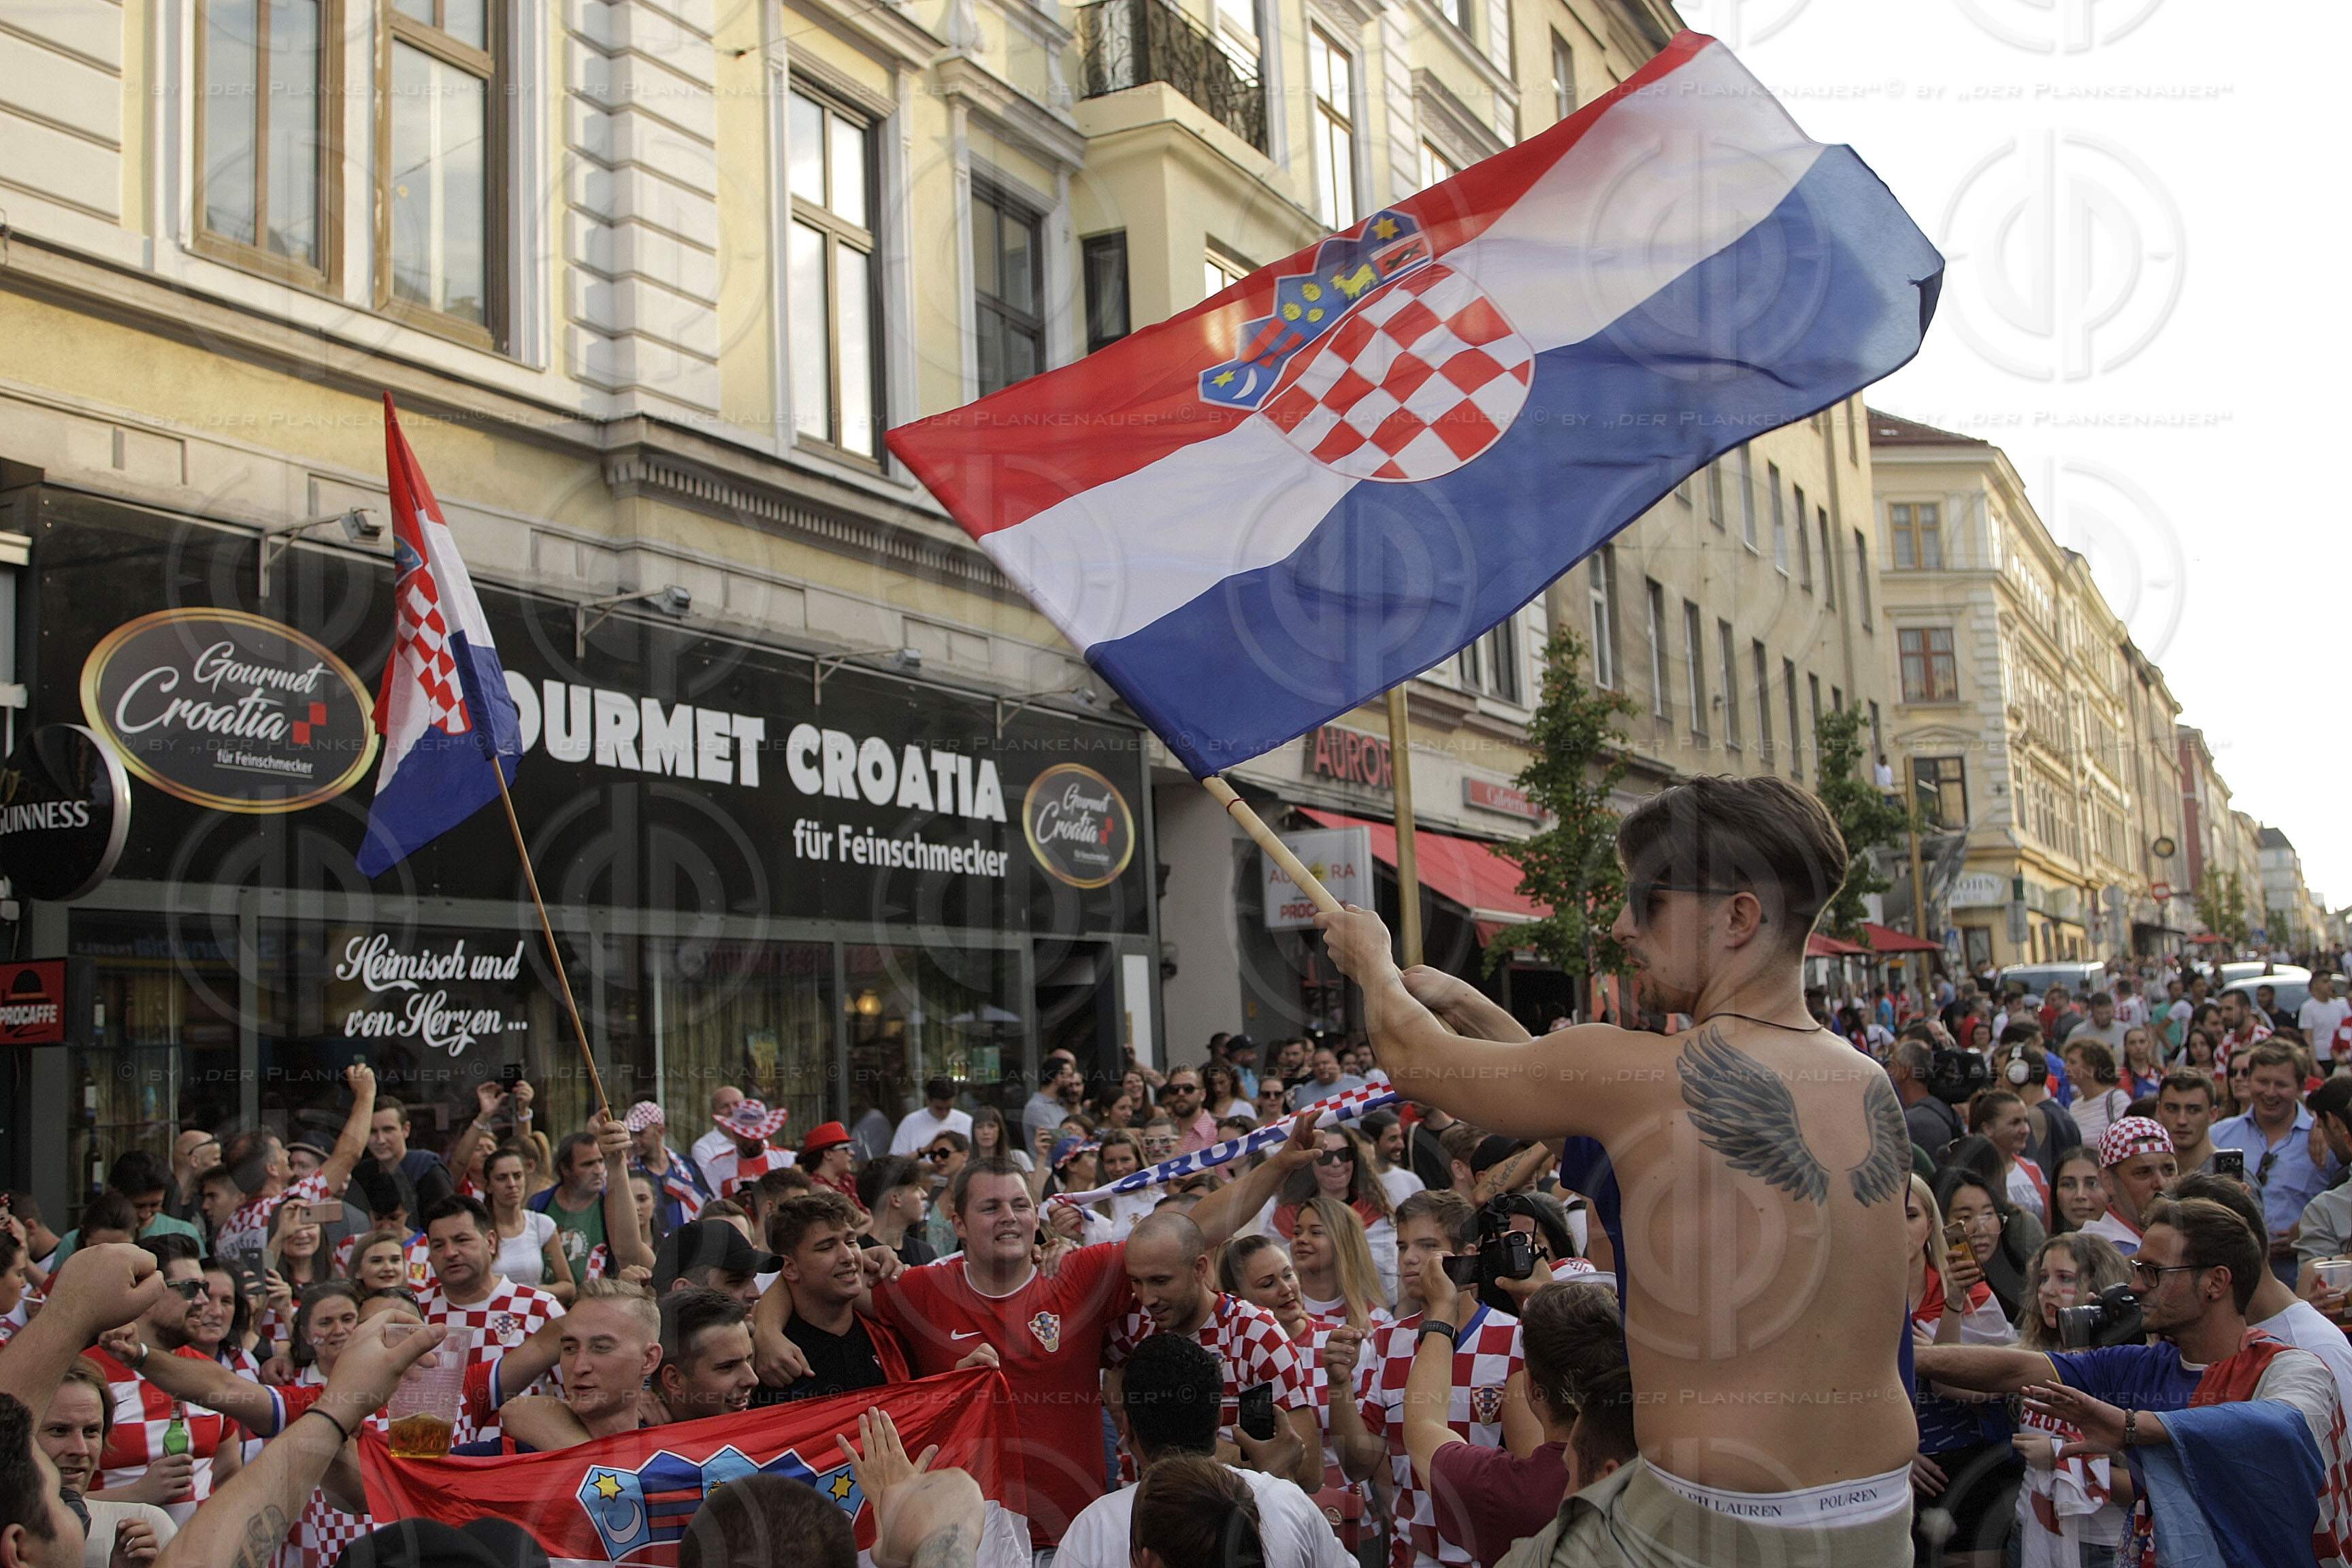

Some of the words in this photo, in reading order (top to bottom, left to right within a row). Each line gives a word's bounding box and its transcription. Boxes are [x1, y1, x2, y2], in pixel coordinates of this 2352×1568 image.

[193, 641, 335, 693] Gourmet
[116, 666, 290, 741] Croatia
[217, 750, 233, 764] für
[235, 751, 314, 774] Feinschmecker
[504, 670, 765, 787] OURMET
[786, 723, 1007, 823] CROATIA
[793, 818, 833, 860] für
[838, 824, 1009, 877] Feinschmecker
[1035, 800, 1098, 845] Croatia
[336, 933, 467, 992] Heimisch
[470, 940, 525, 980] und
[344, 1009, 396, 1037] von
[397, 990, 503, 1056] Herzen
[1714, 1500, 1782, 1518] LAUREN
